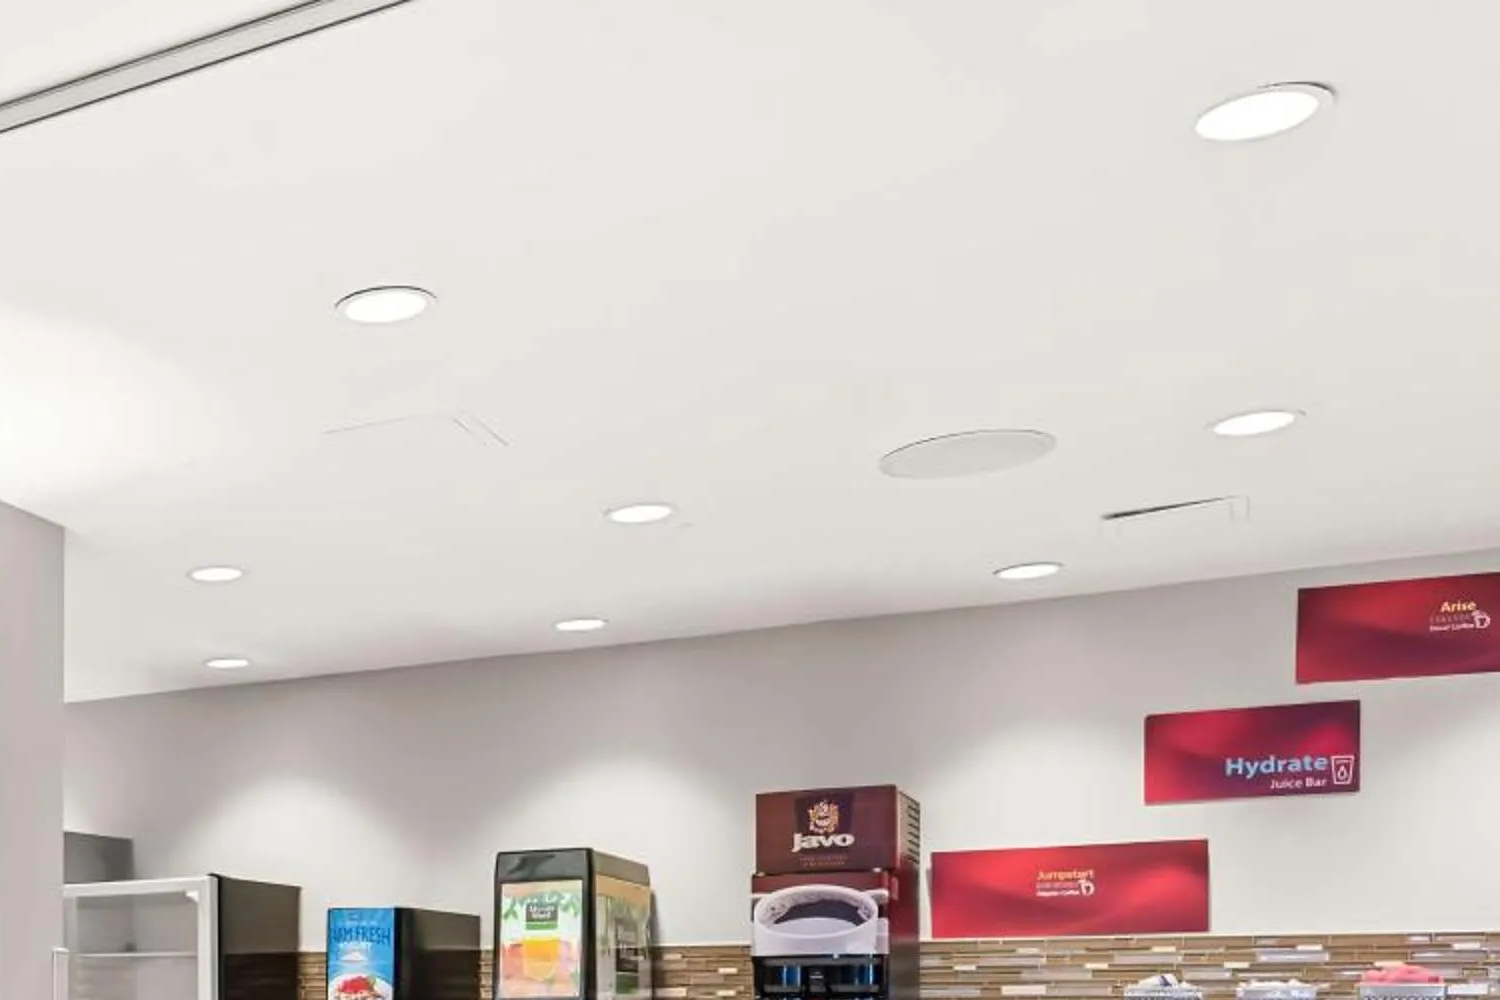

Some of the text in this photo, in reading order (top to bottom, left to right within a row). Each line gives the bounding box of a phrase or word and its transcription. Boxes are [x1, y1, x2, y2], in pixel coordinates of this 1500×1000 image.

[1440, 600, 1477, 613] Arise
[1225, 755, 1329, 779] Hydrate
[1270, 777, 1328, 790] Juice Bar
[1036, 869, 1094, 882] Jumpstart
